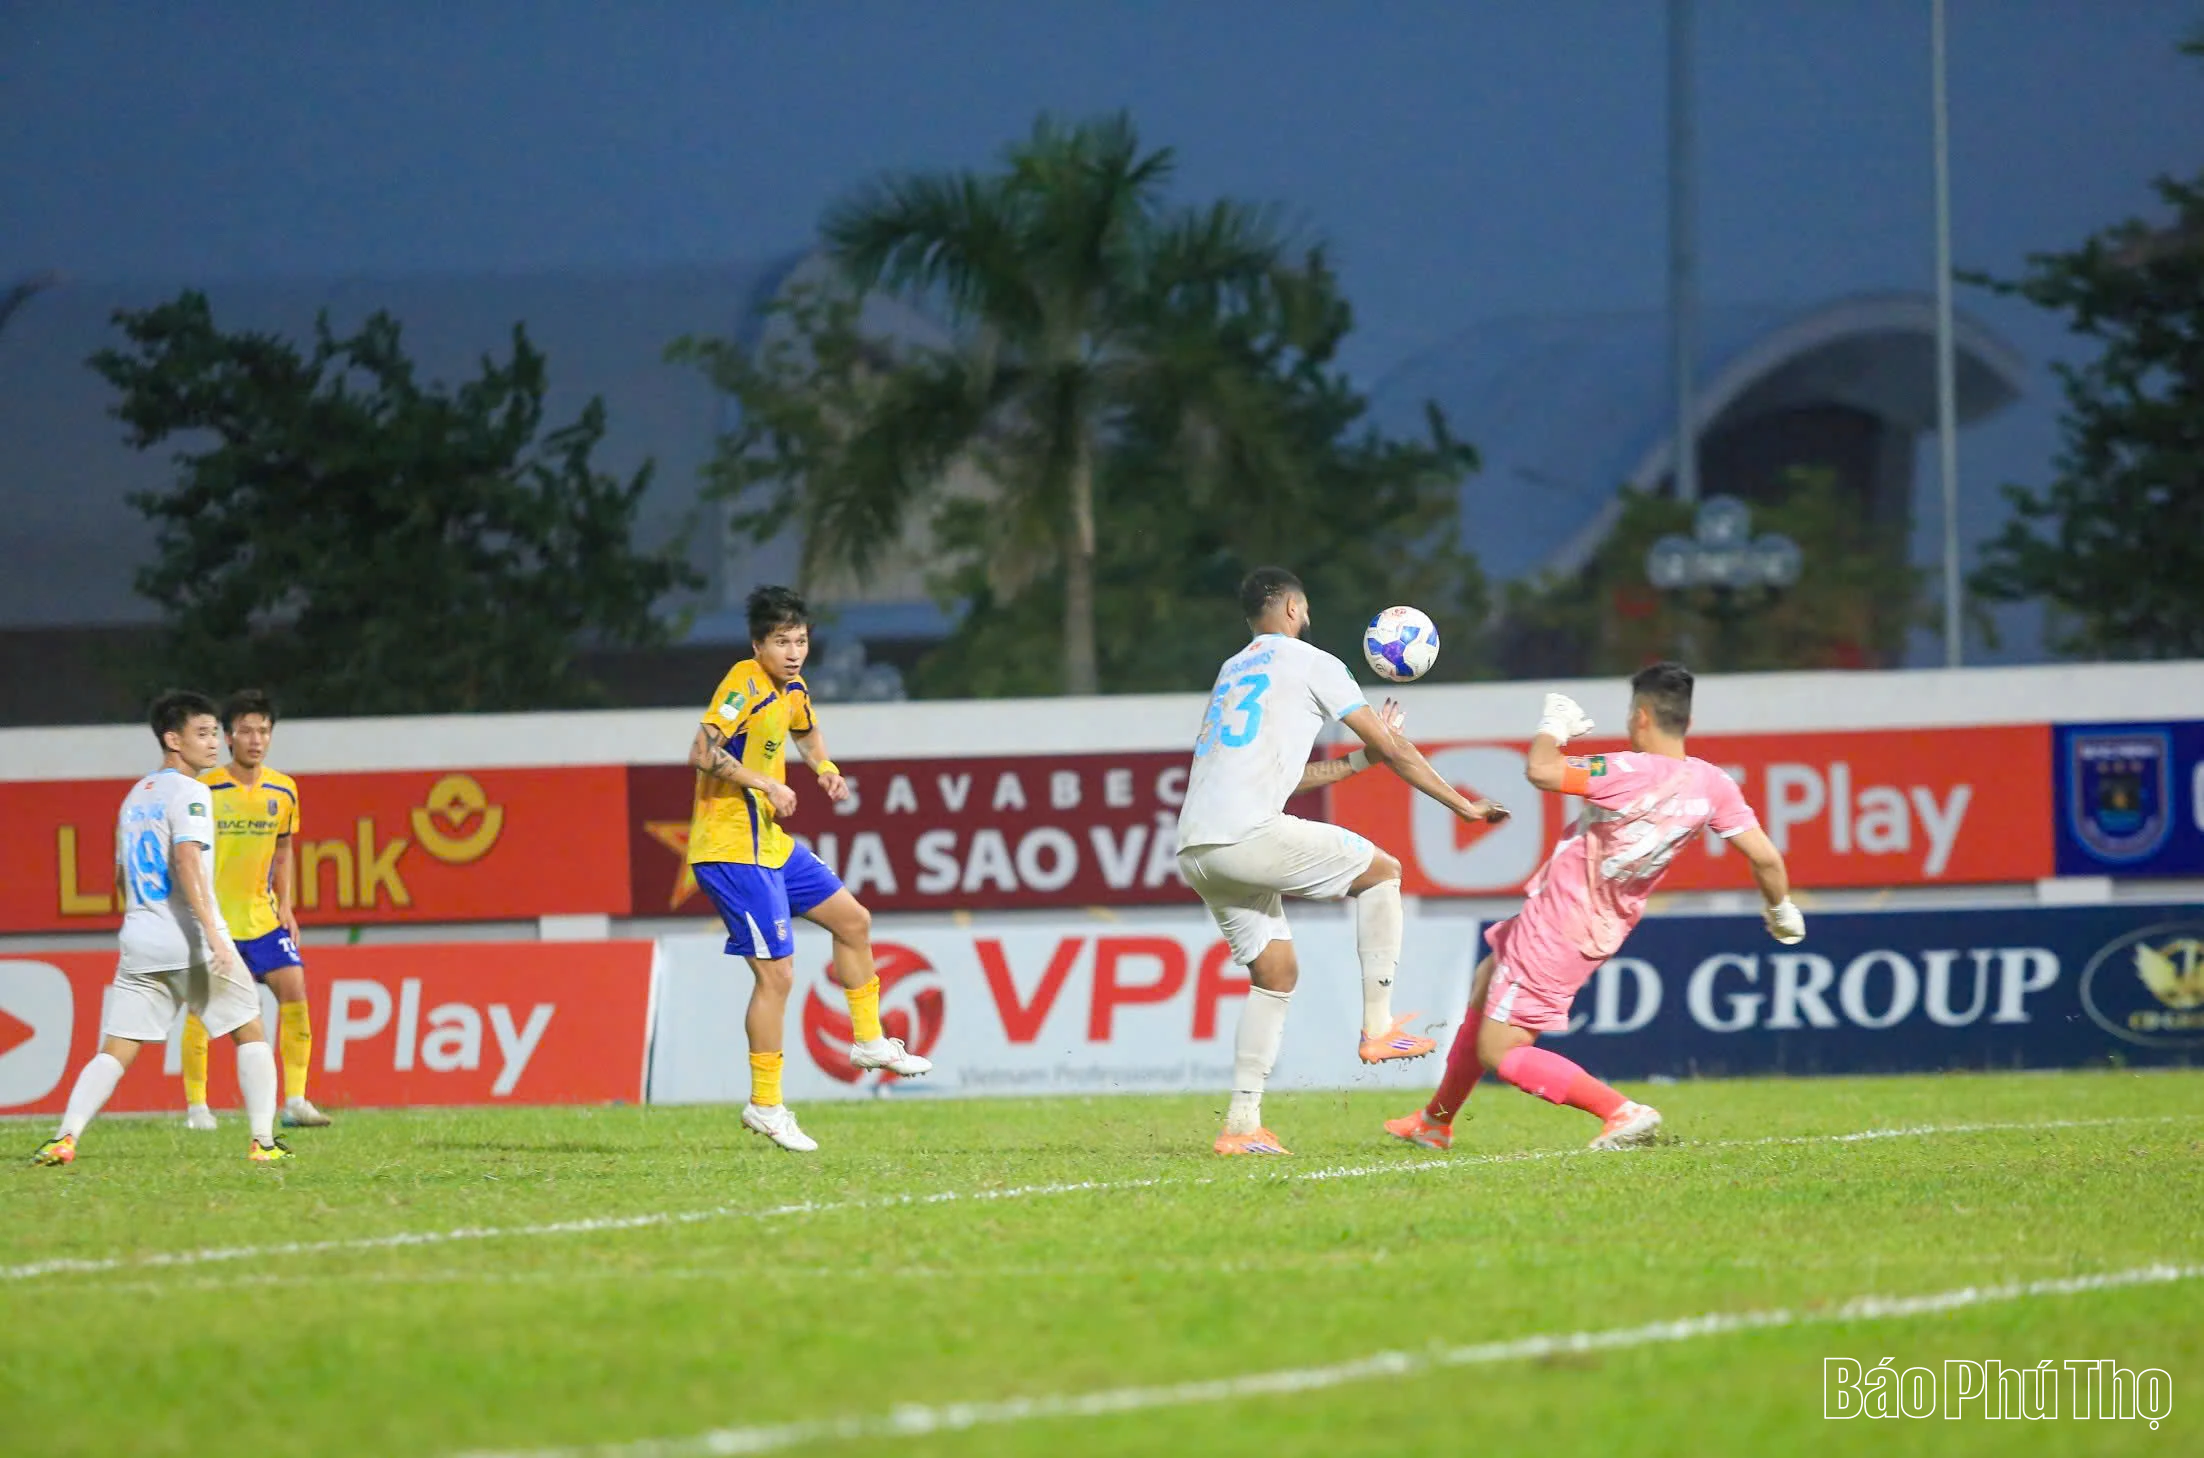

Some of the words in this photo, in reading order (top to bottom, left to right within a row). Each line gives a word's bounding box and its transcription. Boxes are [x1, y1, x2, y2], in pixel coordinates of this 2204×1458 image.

[796, 830, 898, 895] IA
[914, 826, 1079, 895] SAO
[1764, 761, 1973, 877] Play
[127, 829, 172, 905] 19
[322, 977, 555, 1096] Play
[1542, 954, 1664, 1037] D
[1686, 947, 2060, 1033] GROUP
